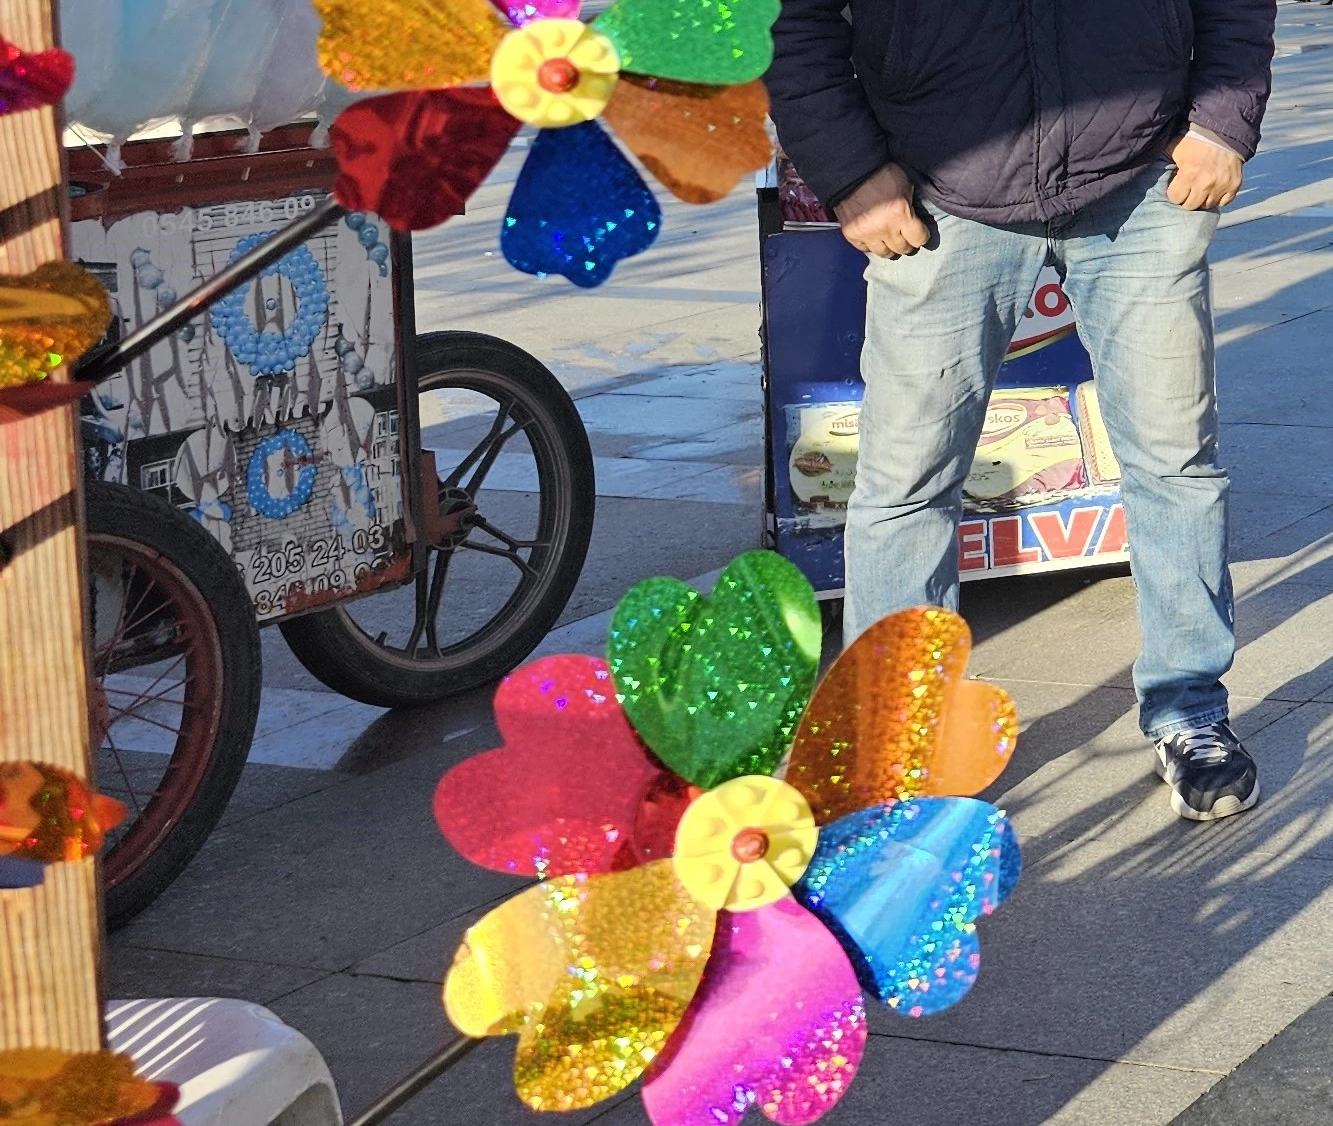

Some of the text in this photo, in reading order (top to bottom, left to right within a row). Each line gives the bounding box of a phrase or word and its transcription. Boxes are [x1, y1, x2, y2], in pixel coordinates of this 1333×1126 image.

[223, 203, 273, 228] 846
[987, 413, 1021, 424] skos
[252, 546, 305, 585] 205
[311, 534, 347, 568] 24
[352, 524, 385, 554] 03
[958, 503, 1129, 572] ELVA
